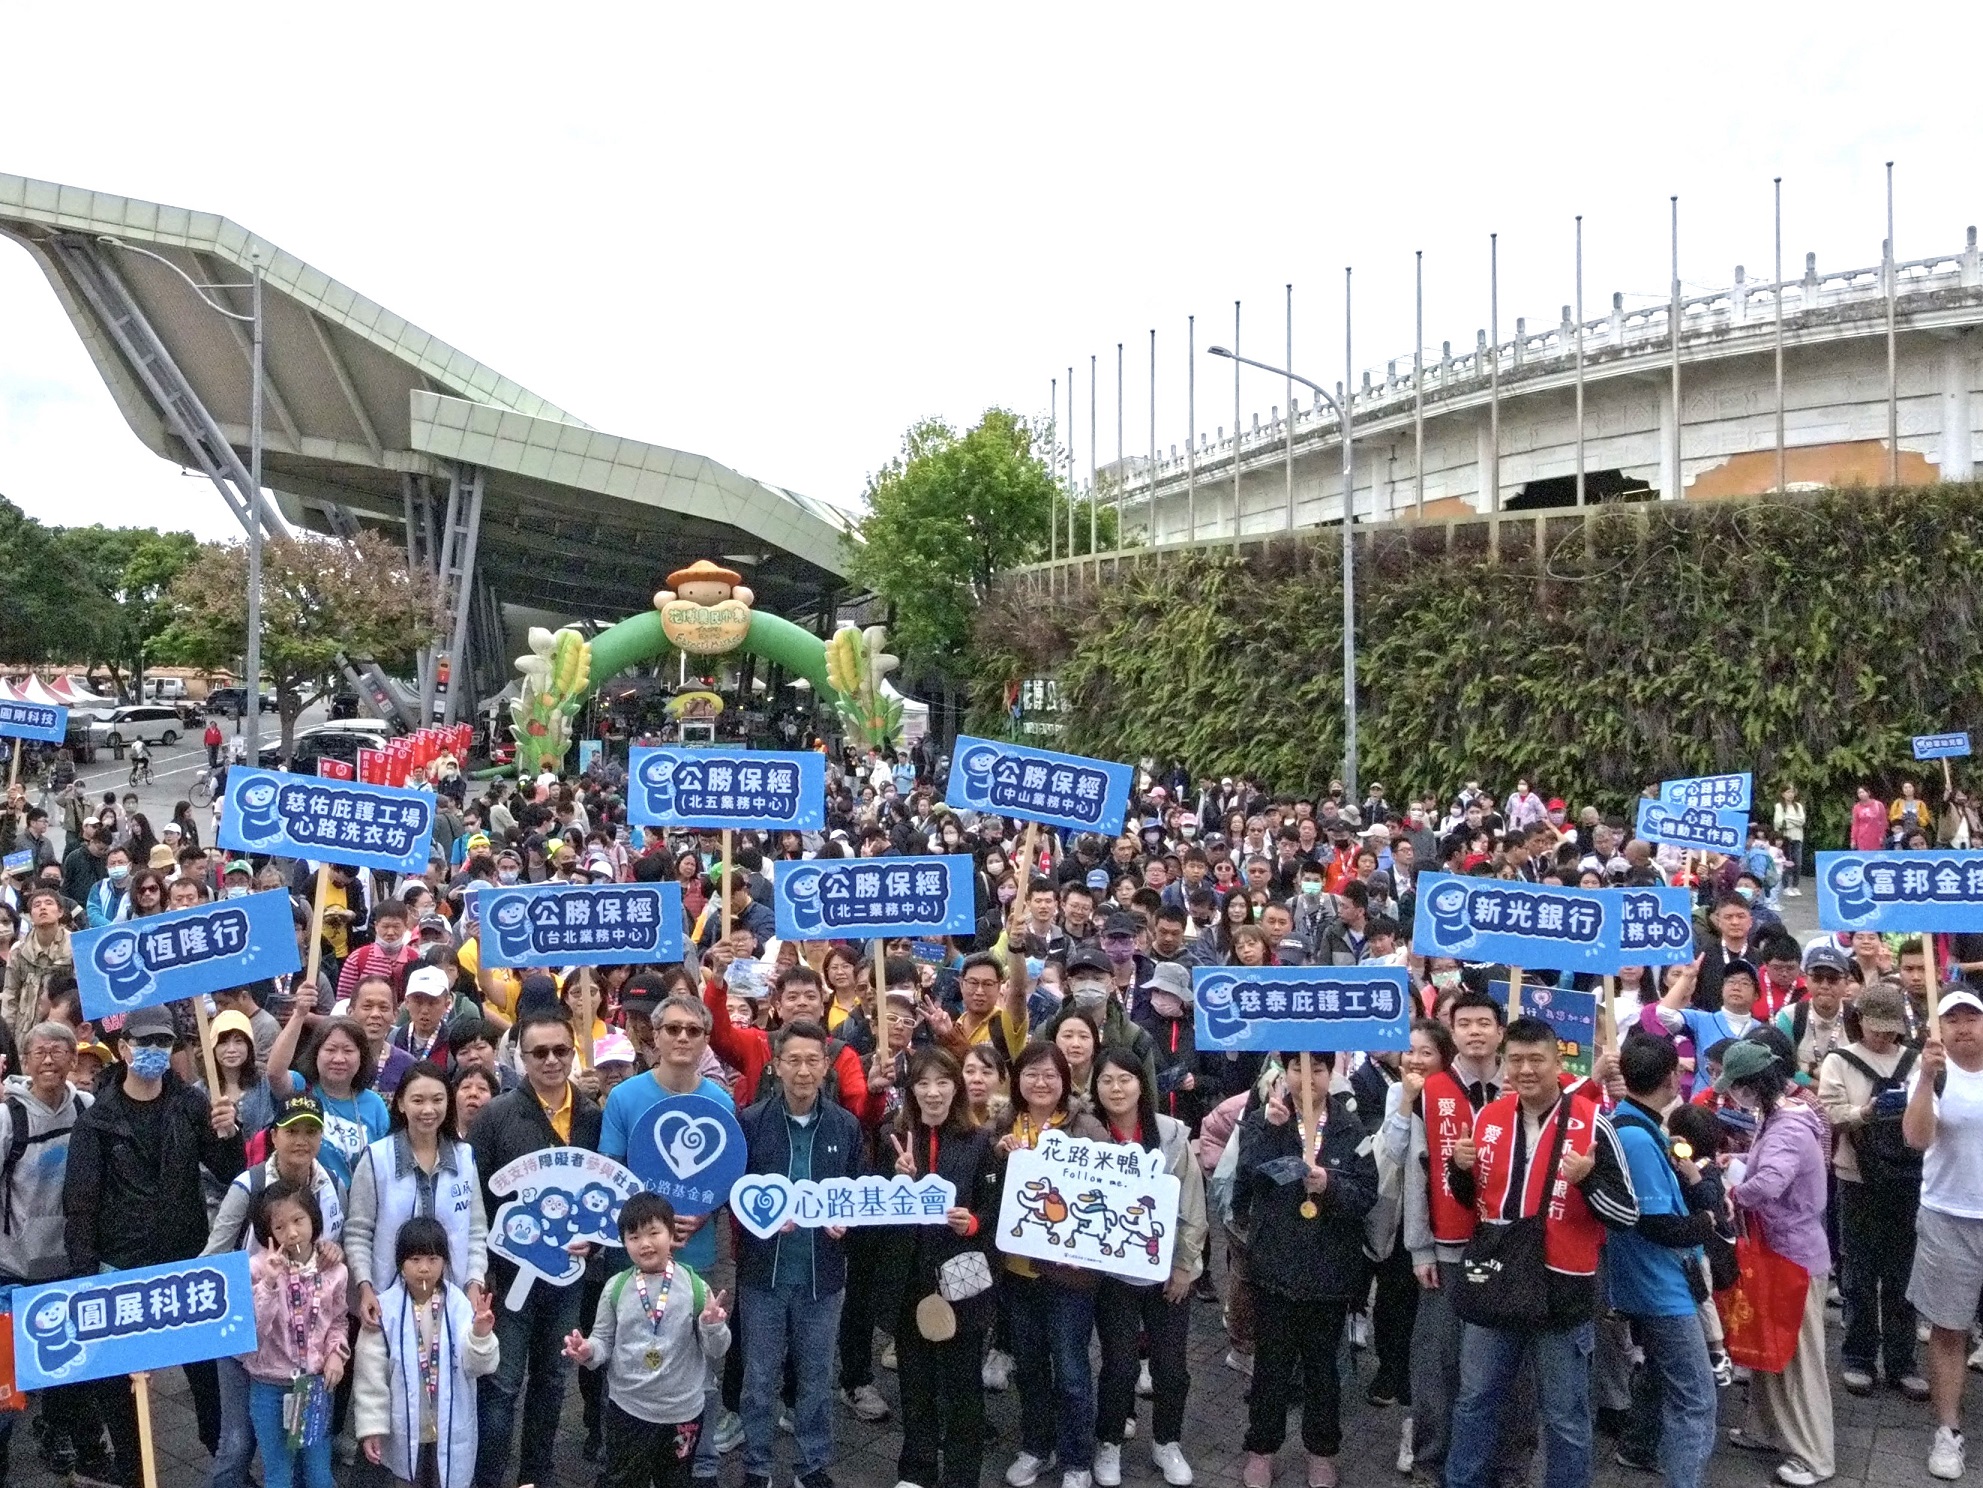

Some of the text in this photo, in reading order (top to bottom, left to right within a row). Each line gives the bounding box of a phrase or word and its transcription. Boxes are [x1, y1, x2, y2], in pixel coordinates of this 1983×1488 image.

[678, 766, 793, 794] 公勝保經
[996, 761, 1102, 800] 公勝保經
[285, 791, 421, 829] 慈佑庇護工場
[681, 794, 790, 812] (北五業務中心)
[996, 786, 1096, 817] (中山業務中心)
[294, 815, 407, 849] 心路洗衣坊
[1662, 821, 1735, 844] 機動工作隊
[1684, 811, 1713, 827] 心路
[825, 870, 942, 899] 公勝保經
[534, 897, 654, 926] 公勝保經
[829, 901, 939, 919] (北二業務中心)
[1474, 895, 1596, 935] 新光銀行
[539, 927, 650, 946] (台北業務中心)
[1620, 921, 1684, 943] 務中心
[1239, 989, 1394, 1013] 慈泰庇護工場
[1062, 1168, 1103, 1184] Follow
[643, 1177, 715, 1205] 心路基金會
[794, 1184, 948, 1220] 心路基金會
[77, 1278, 219, 1333] 圓展科技
